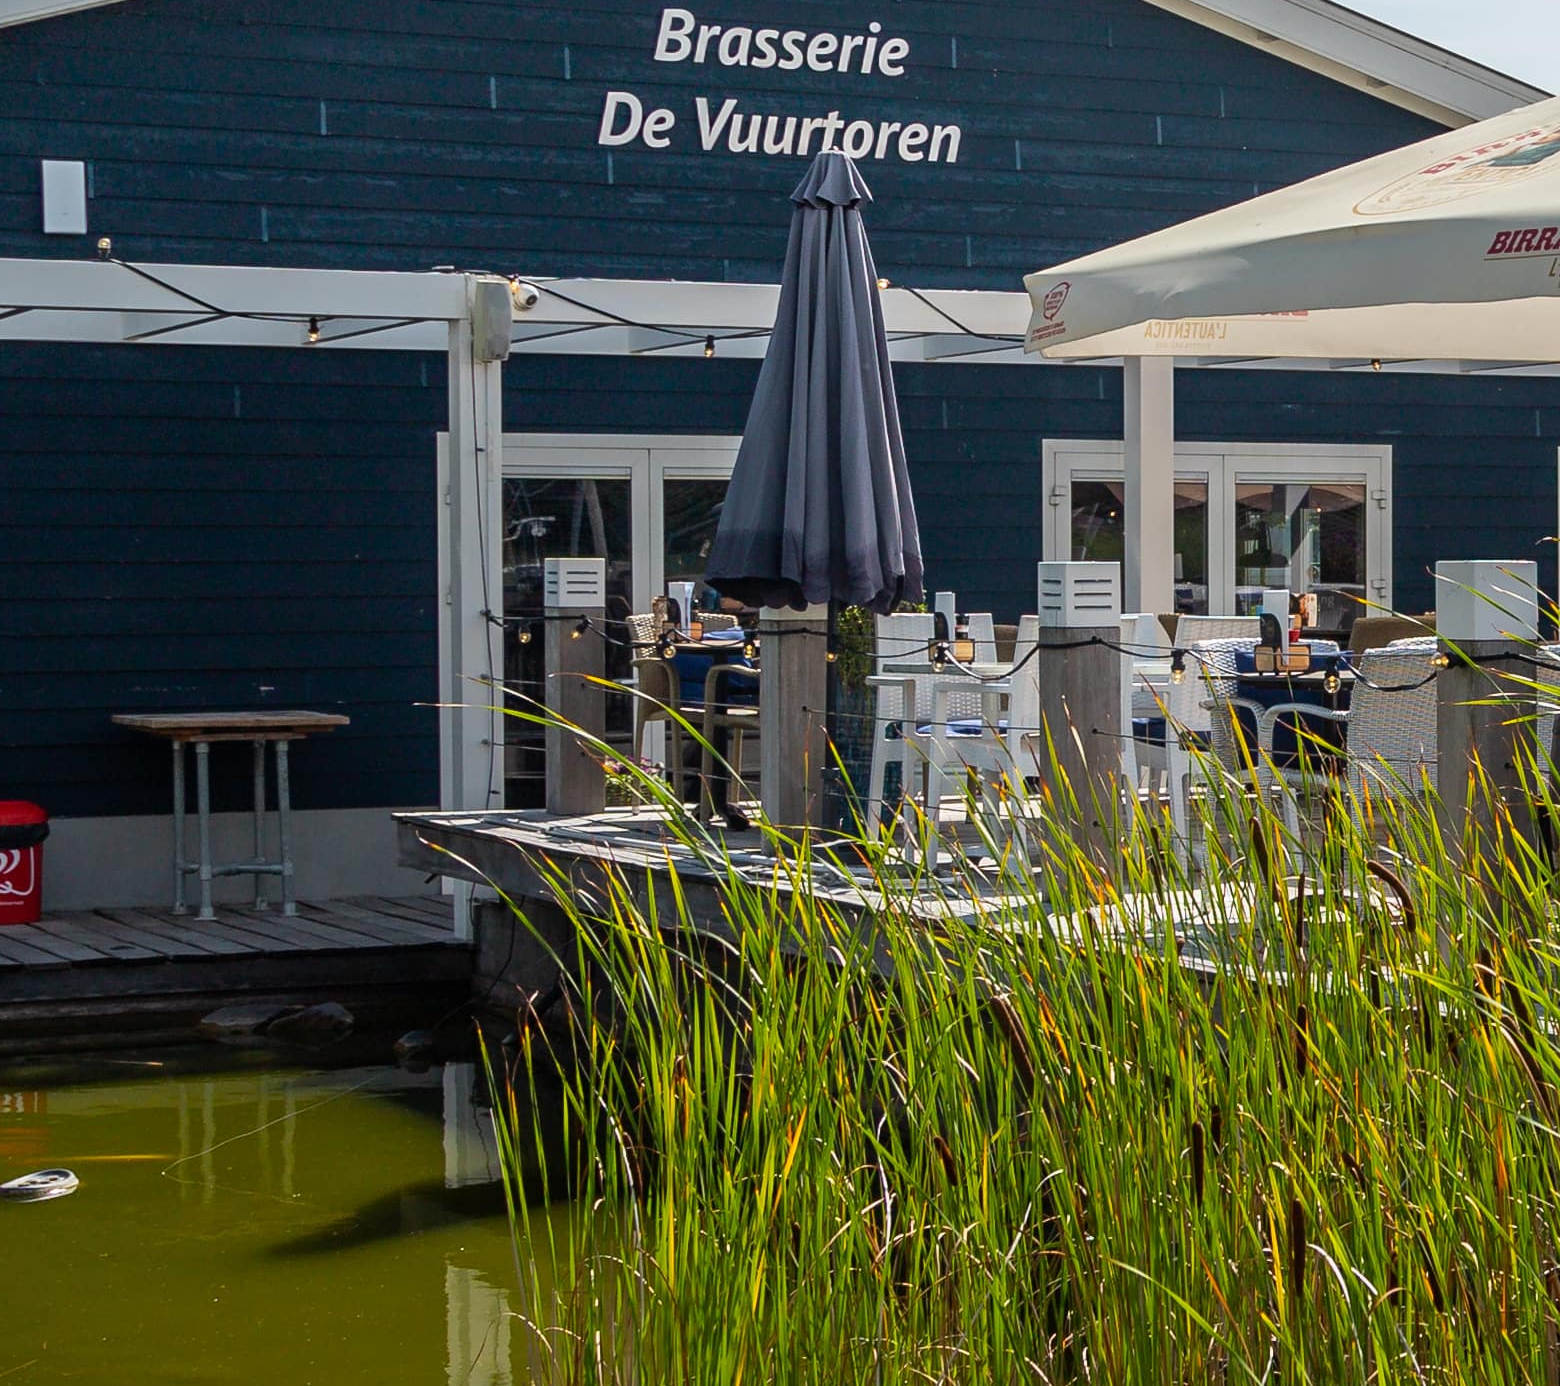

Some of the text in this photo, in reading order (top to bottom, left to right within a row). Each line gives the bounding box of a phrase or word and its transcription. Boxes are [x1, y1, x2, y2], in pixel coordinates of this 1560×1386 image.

[653, 8, 910, 77] Brasserie
[598, 91, 962, 164] De Vuurtoren
